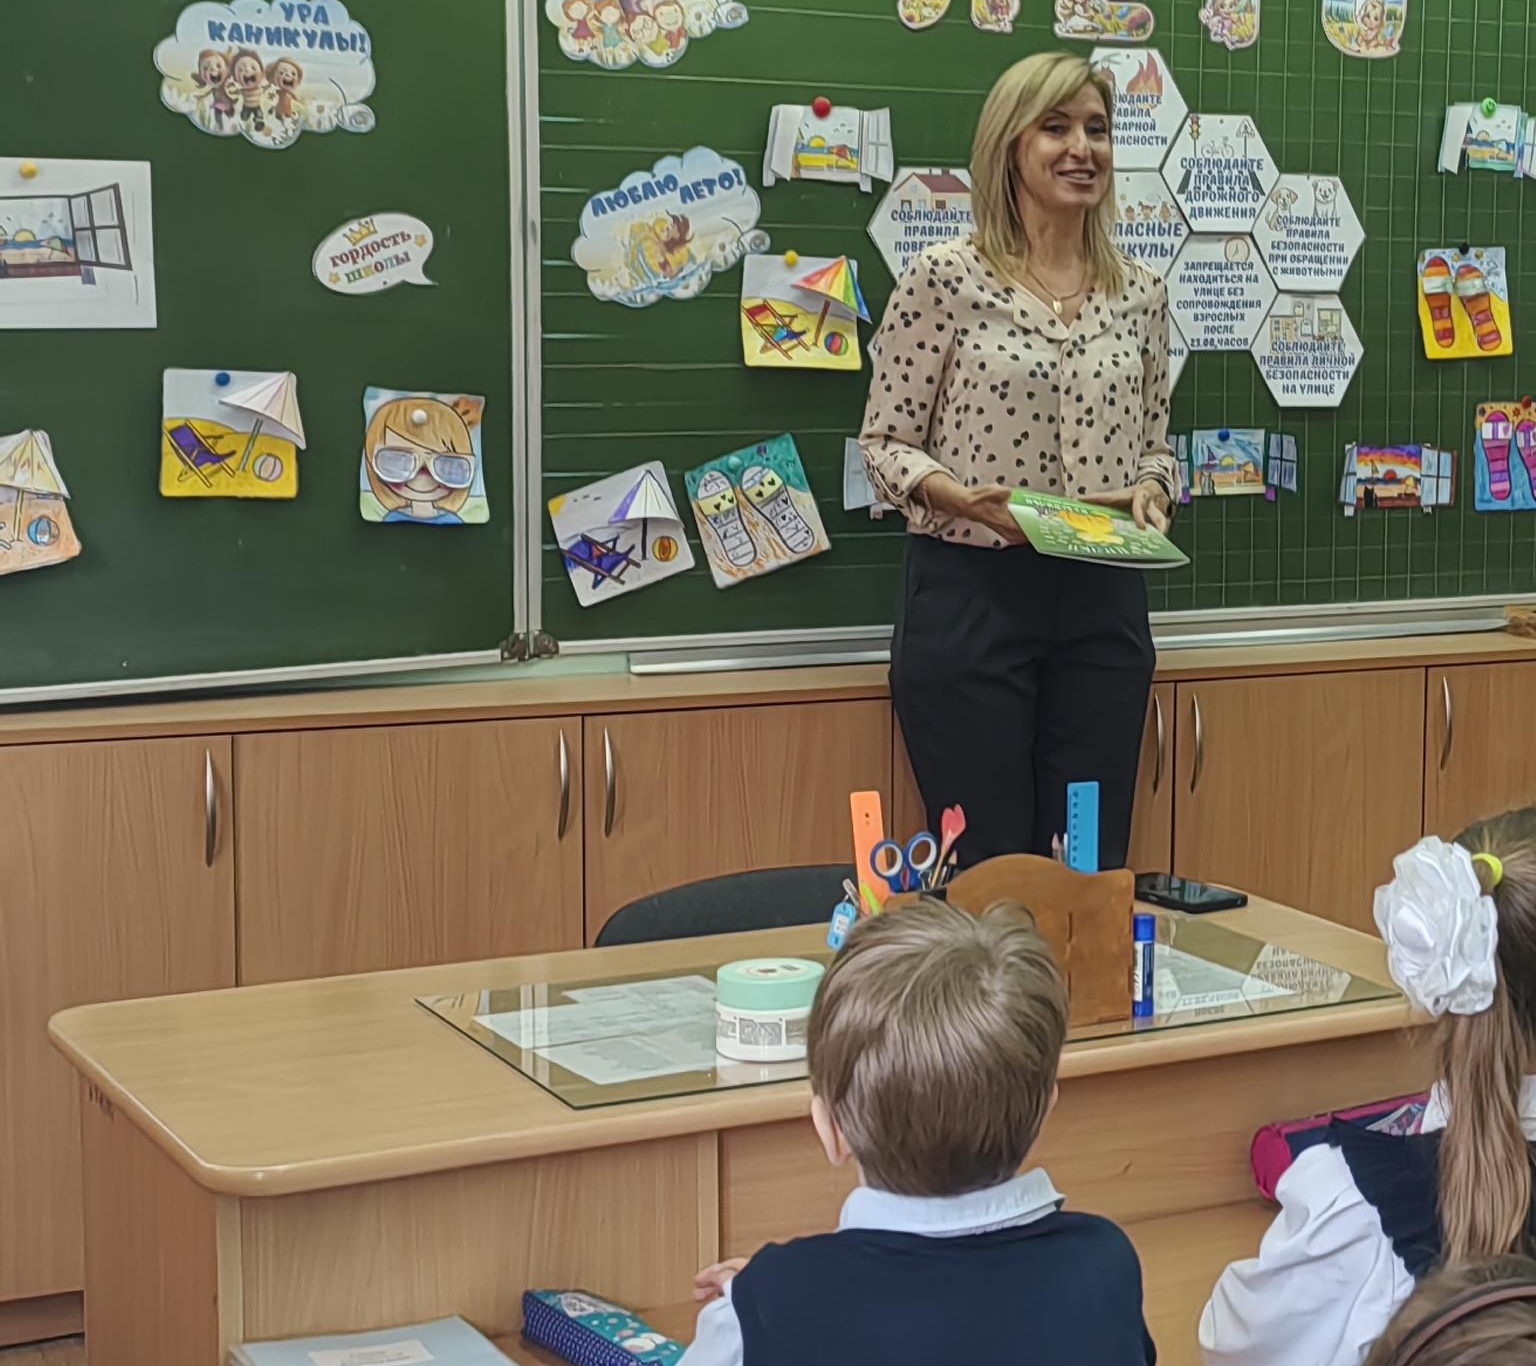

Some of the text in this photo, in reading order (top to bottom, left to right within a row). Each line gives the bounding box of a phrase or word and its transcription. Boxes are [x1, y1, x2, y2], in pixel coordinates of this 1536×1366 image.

[279, 1, 329, 26] УРА
[207, 20, 367, 53] КАНИКУЛЫ!
[1113, 107, 1151, 118] АВИЛА
[1113, 135, 1168, 146] ПАСНОСТИ
[679, 168, 745, 204] ЛЕТО!
[591, 174, 678, 217] ЛЮБЛЮ
[1185, 190, 1259, 204] ДОРОЖНОГО
[1189, 206, 1256, 220] ДВИЖЕНИЯ
[904, 225, 959, 237] ПРАВИЛА
[1114, 221, 1184, 237] ПАСНЫЕ
[1286, 228, 1330, 240] ПРАВИЛА
[330, 231, 411, 267] гордость
[1271, 241, 1345, 253] БЕЗОПАСНОСТИ
[1268, 253, 1349, 266] ПРИ ОБРАЩЕНИИ
[344, 251, 411, 284] школы
[1183, 261, 1254, 272] ЗАПРЕЩАЕТСЯ
[1272, 266, 1343, 278] С ЖИВОТНЫМИ
[1179, 274, 1259, 285] НАХОДИТЬСЯ НА
[1193, 287, 1244, 298] УЛИЦЕ БЕЗ
[1176, 299, 1262, 310] СОПРОВОЖДЕНИЯ
[1193, 313, 1245, 322] ВЗРОСЛЫХ
[1203, 325, 1234, 335] ПОСЛЕ
[1260, 353, 1355, 366] ПРАВИЛА ЛИЧНОЙ
[1266, 369, 1350, 381] БЕЗОПАСНОСТИ
[1282, 383, 1335, 397] НА УЛИЦЕ
